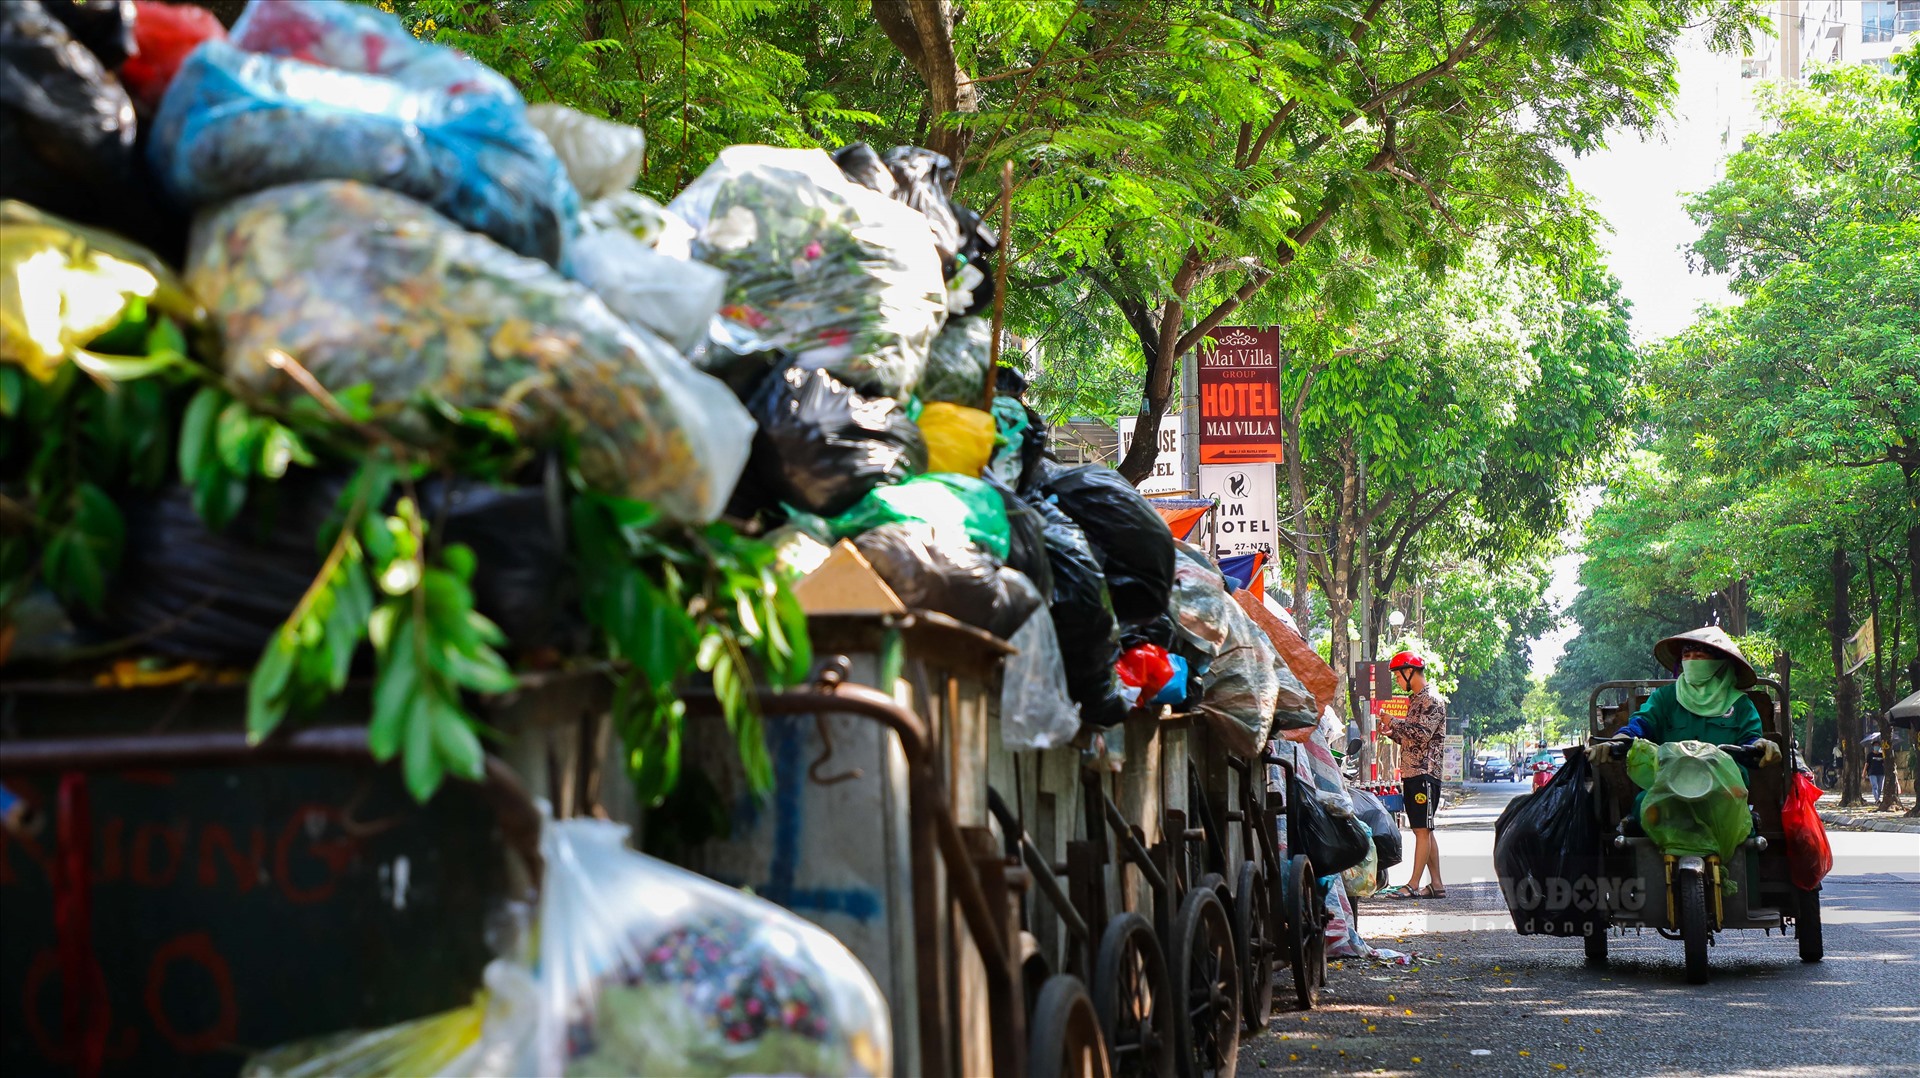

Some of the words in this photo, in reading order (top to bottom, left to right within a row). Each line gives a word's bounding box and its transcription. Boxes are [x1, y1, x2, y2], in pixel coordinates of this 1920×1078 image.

[1205, 349, 1234, 366] Mai
[1238, 349, 1273, 366] Villa
[1222, 370, 1256, 378] GROUP
[1202, 383, 1278, 417] HOTEL
[1206, 422, 1231, 436] MAI
[1235, 421, 1275, 436] VILLA
